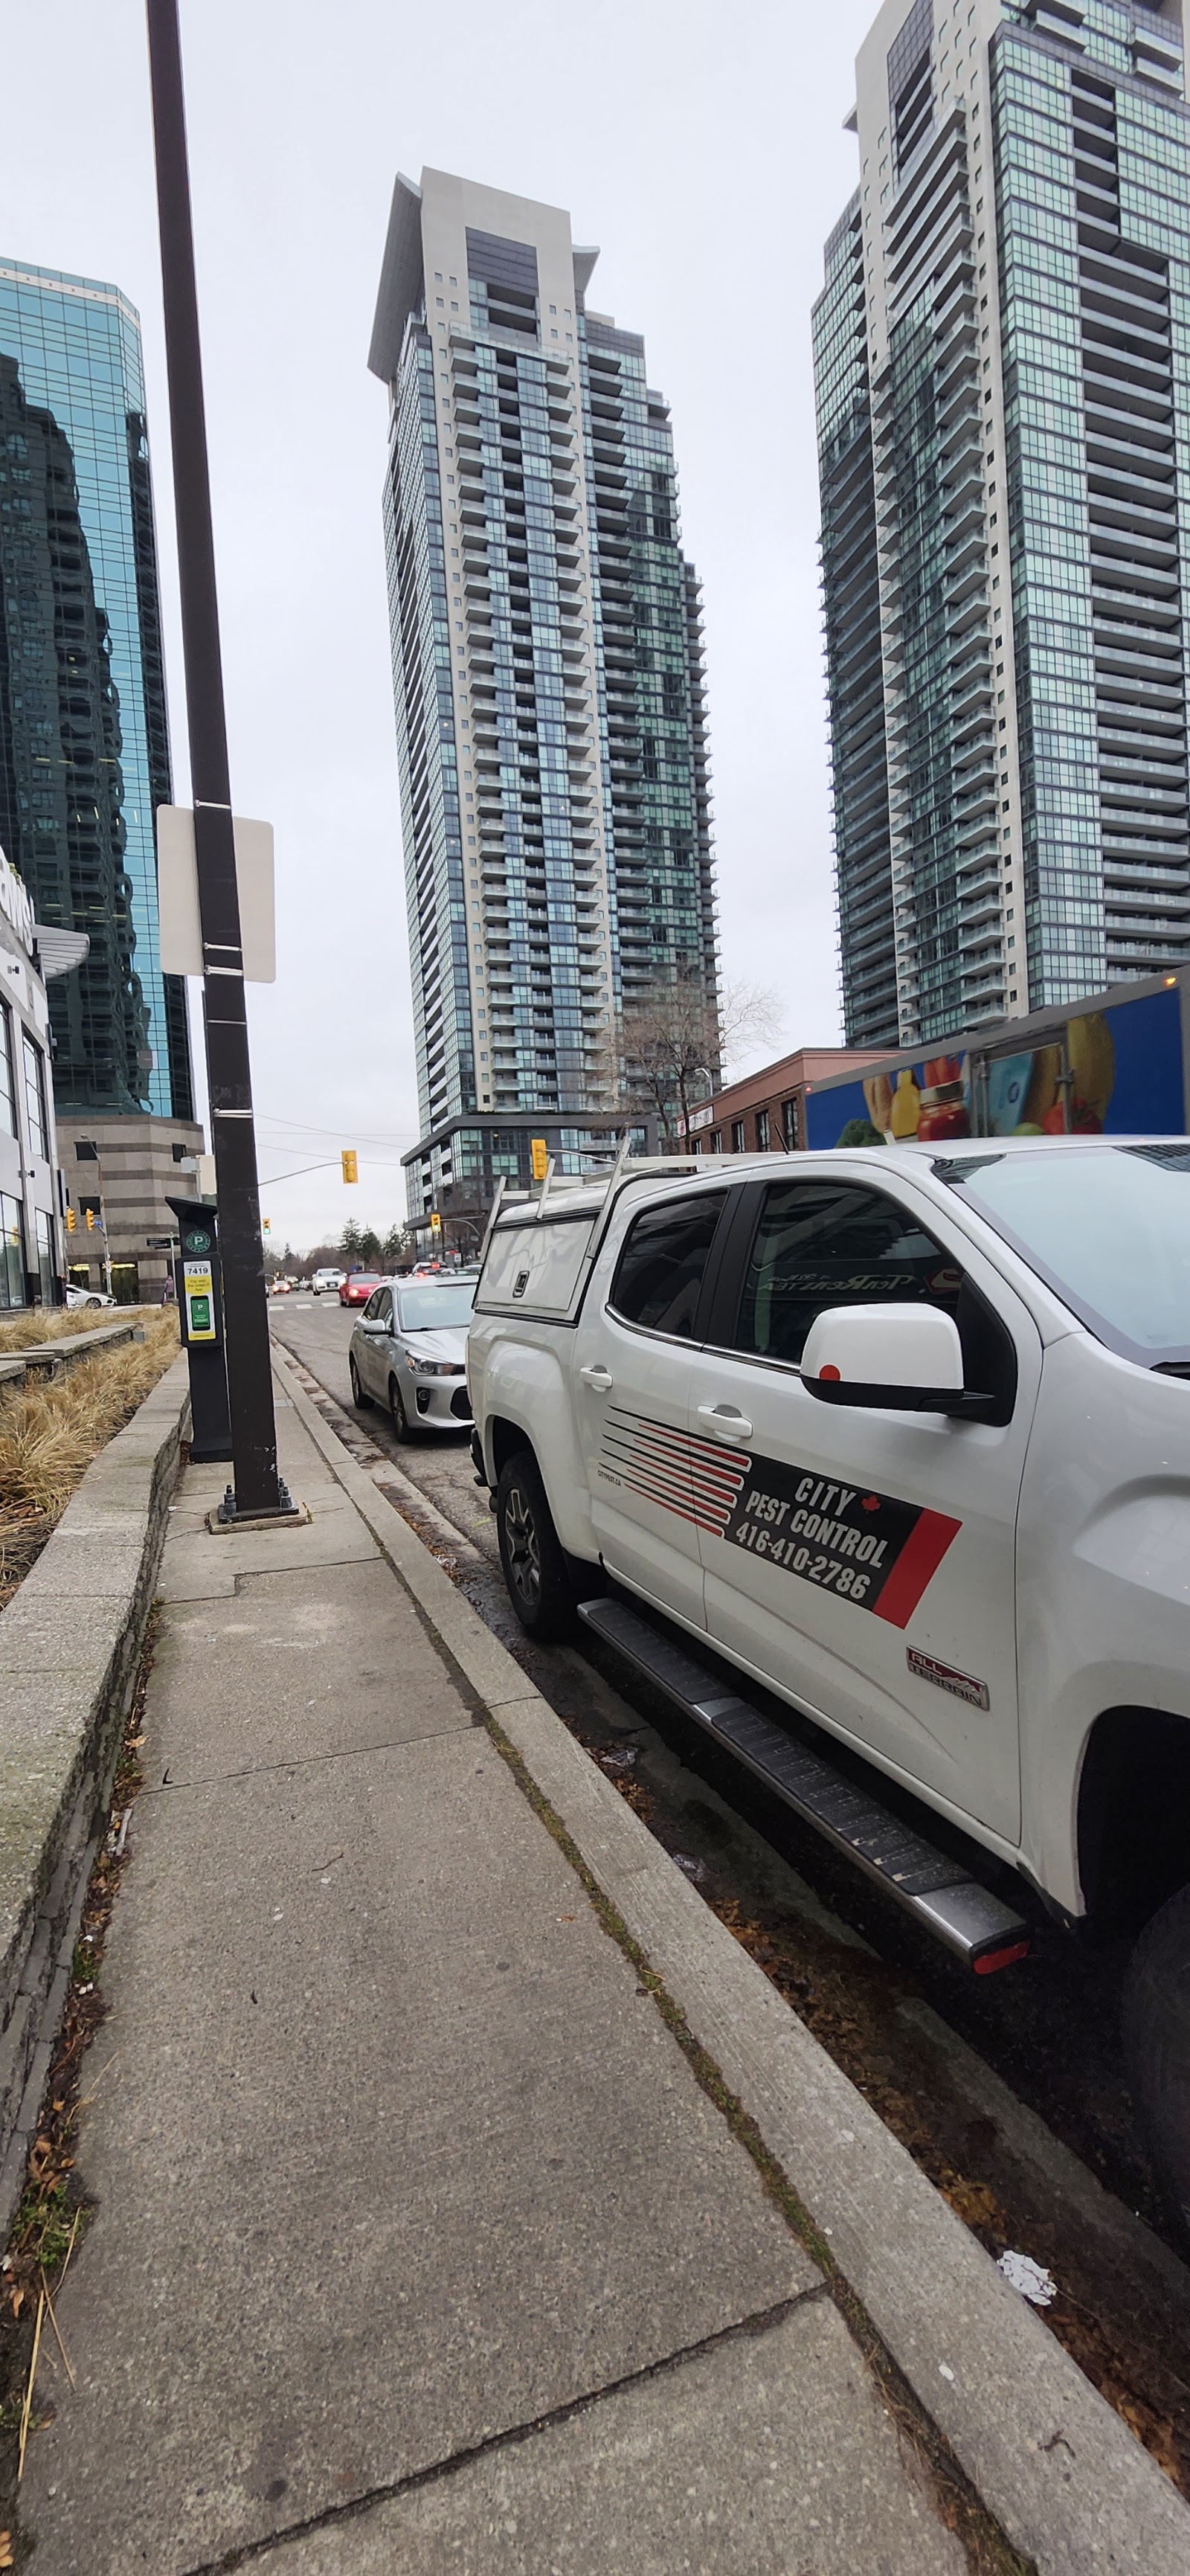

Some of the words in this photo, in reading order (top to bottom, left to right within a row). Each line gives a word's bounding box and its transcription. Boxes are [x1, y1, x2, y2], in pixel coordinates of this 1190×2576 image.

[795, 1477, 857, 1516] CITY
[745, 1491, 791, 1526] PEST
[791, 1509, 888, 1569] CONTROL
[736, 1521, 871, 1599] 416-410-2786
[909, 1661, 982, 1706] TERRAIN
[911, 1652, 942, 1675] ALL
